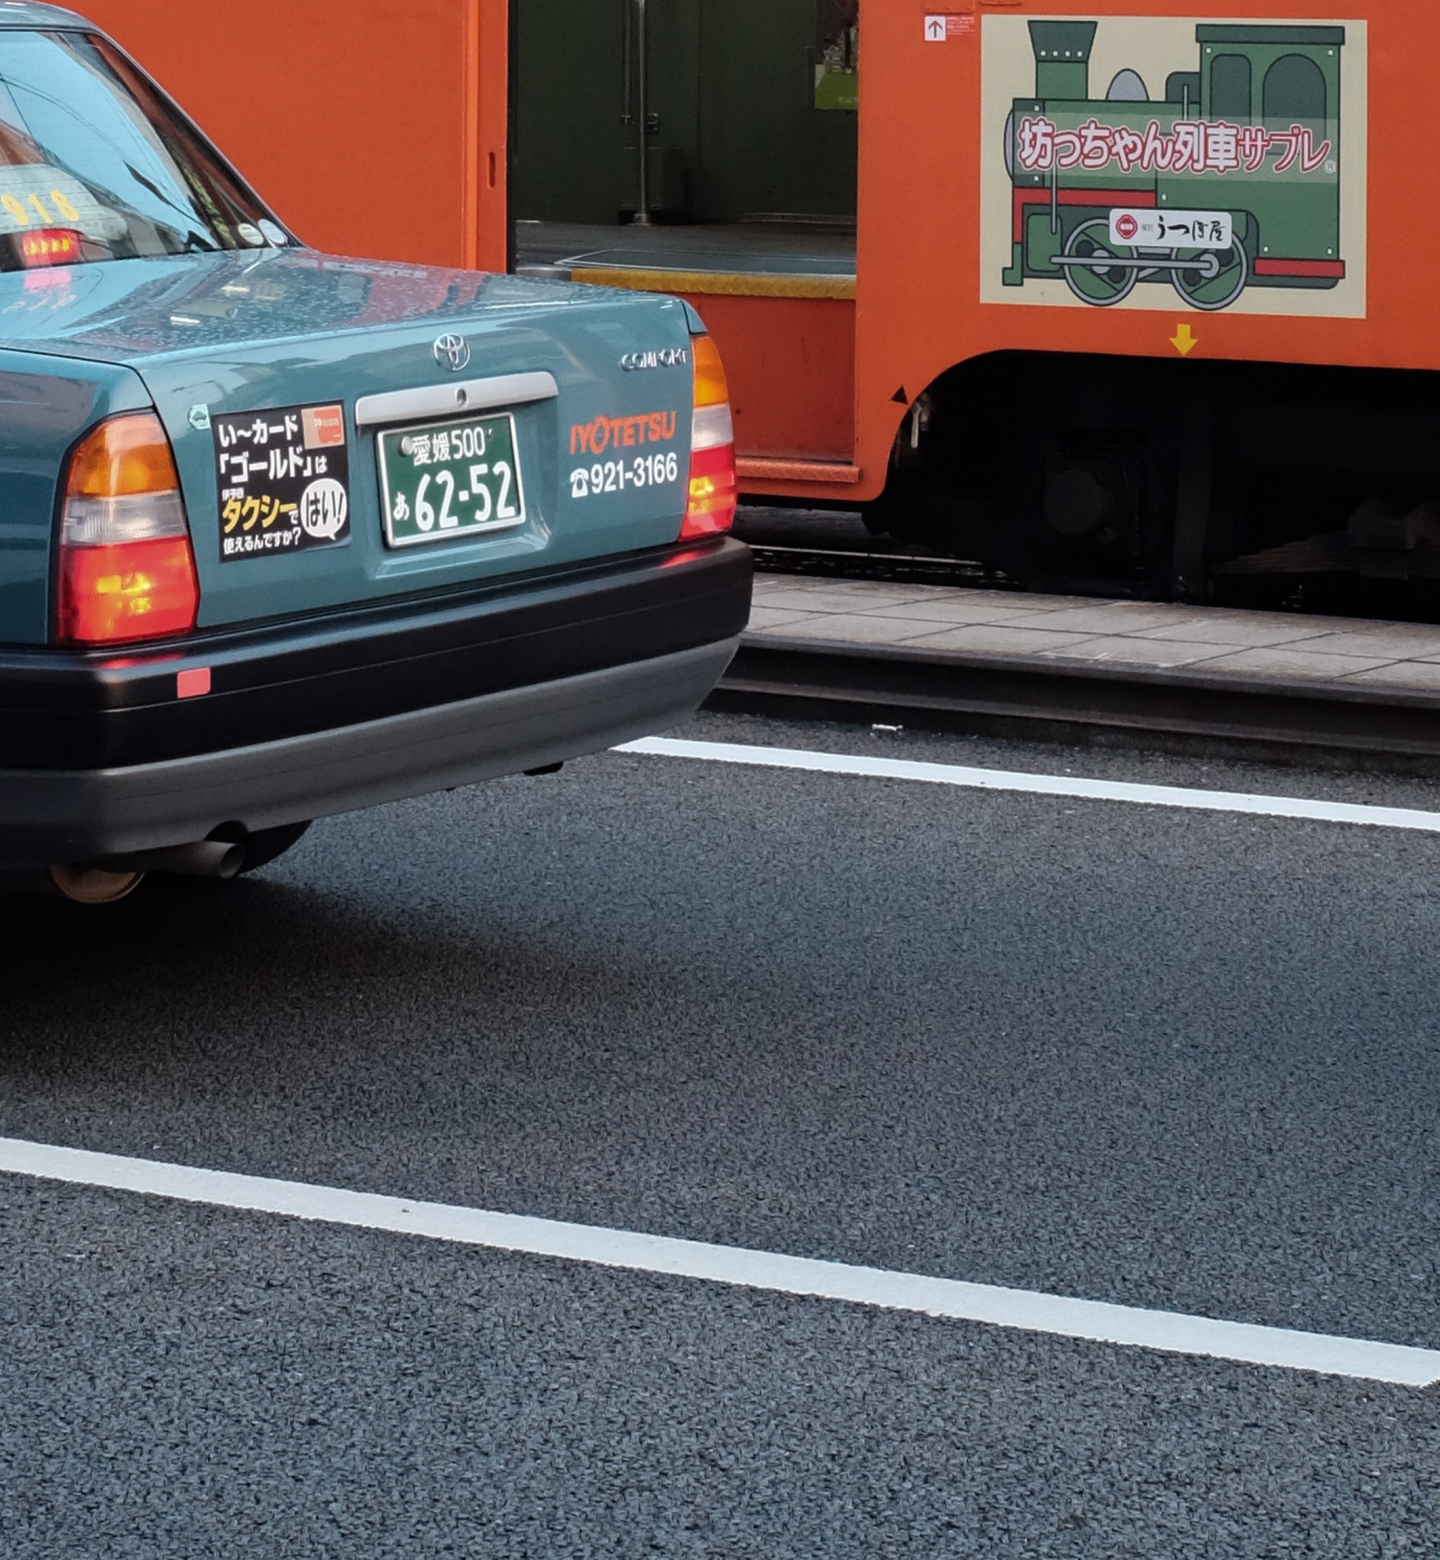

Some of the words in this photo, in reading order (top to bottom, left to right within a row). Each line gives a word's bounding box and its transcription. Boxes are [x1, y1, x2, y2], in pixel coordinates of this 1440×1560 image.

[1018, 117, 1331, 174] 坊っちゃん列車サブレ
[569, 410, 677, 455] IYOTETSU
[393, 491, 410, 521] あ
[414, 461, 516, 532] 62-52
[591, 452, 678, 495] 921-3166
